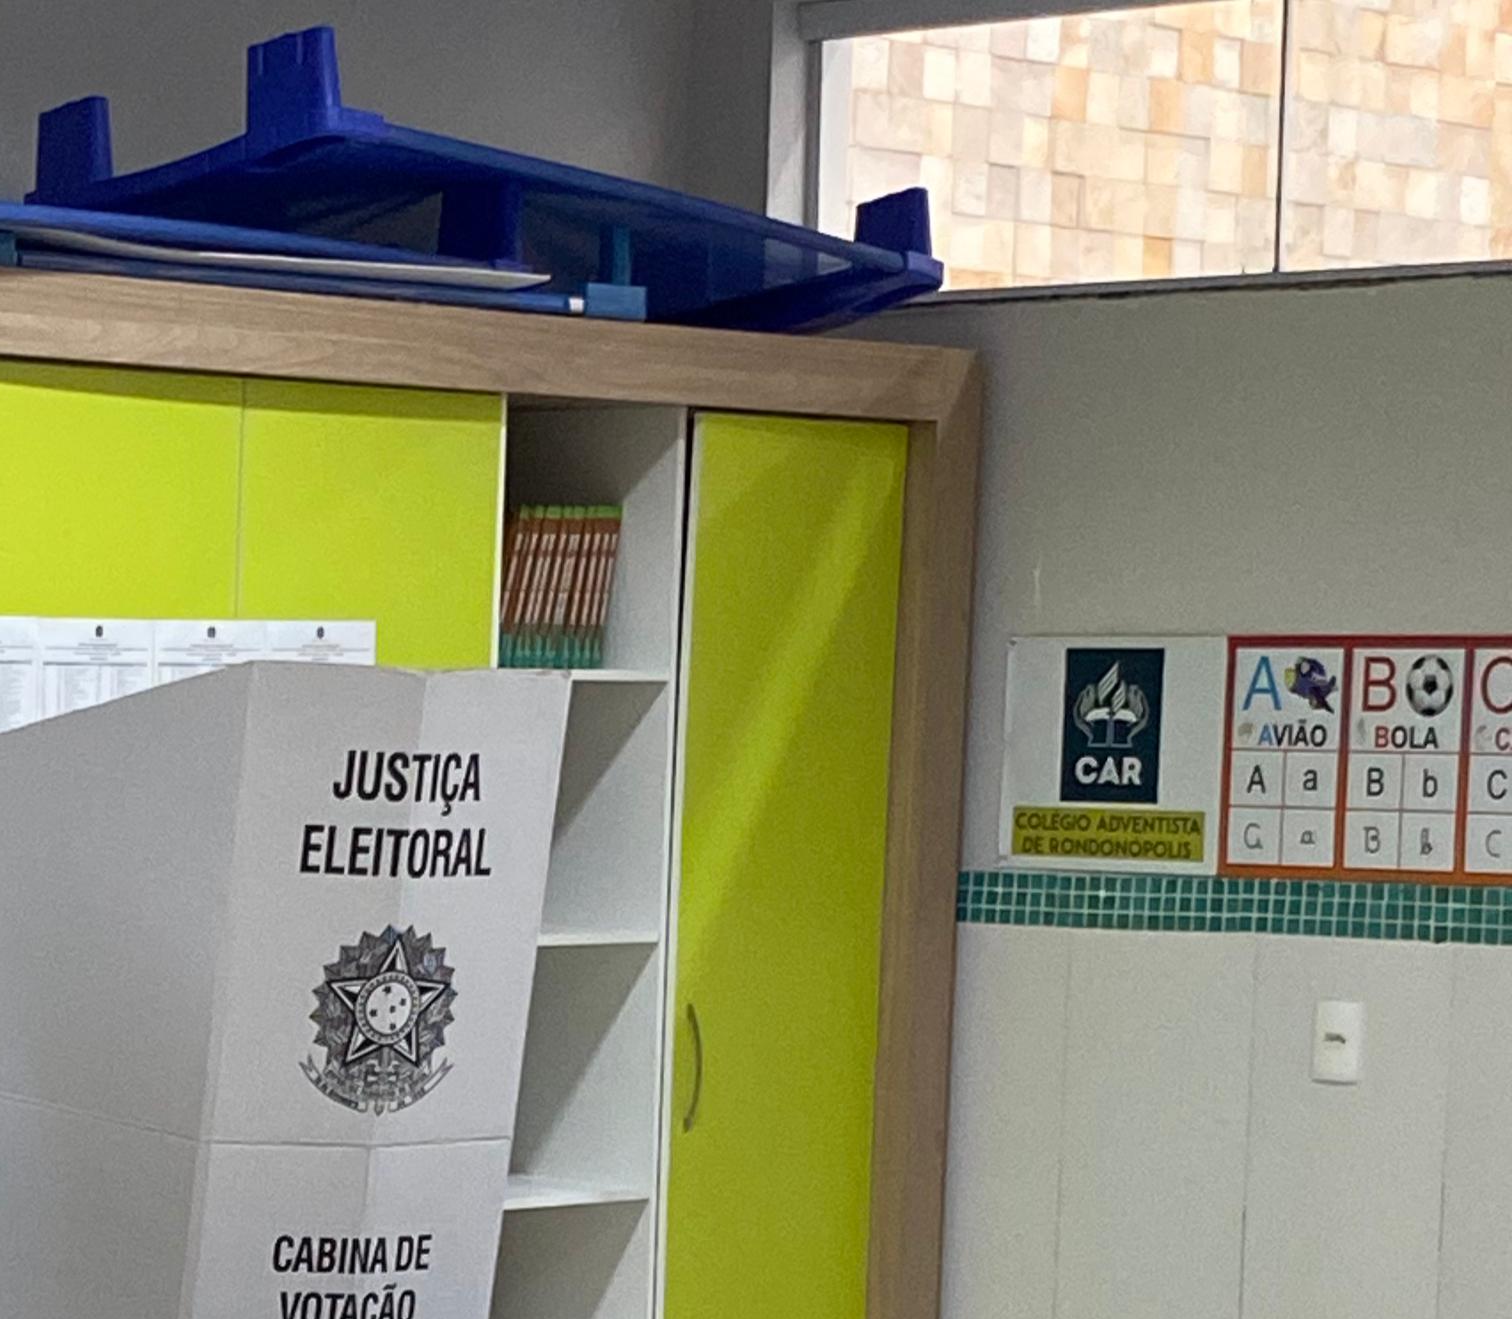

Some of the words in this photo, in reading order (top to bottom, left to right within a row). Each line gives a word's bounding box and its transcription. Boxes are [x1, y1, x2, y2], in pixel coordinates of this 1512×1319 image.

[1242, 656, 1281, 711] A
[1362, 656, 1397, 712] B
[1481, 656, 1512, 714] C
[1258, 719, 1327, 747] AVIÃO
[1374, 726, 1439, 749] BOLA
[333, 749, 481, 816] JUSTIÇA
[1074, 756, 1142, 785] CAR
[1246, 764, 1266, 794] A
[1303, 769, 1318, 791] a
[1366, 767, 1384, 797] B
[1422, 768, 1438, 798] b
[1487, 769, 1507, 800] C
[1096, 815, 1201, 836] ADVENTISTA
[1363, 826, 1381, 853] B
[299, 824, 492, 878] ELEITORAL
[1022, 836, 1044, 854] DE
[272, 1235, 387, 1274] CABINA
[395, 1234, 432, 1272] DE
